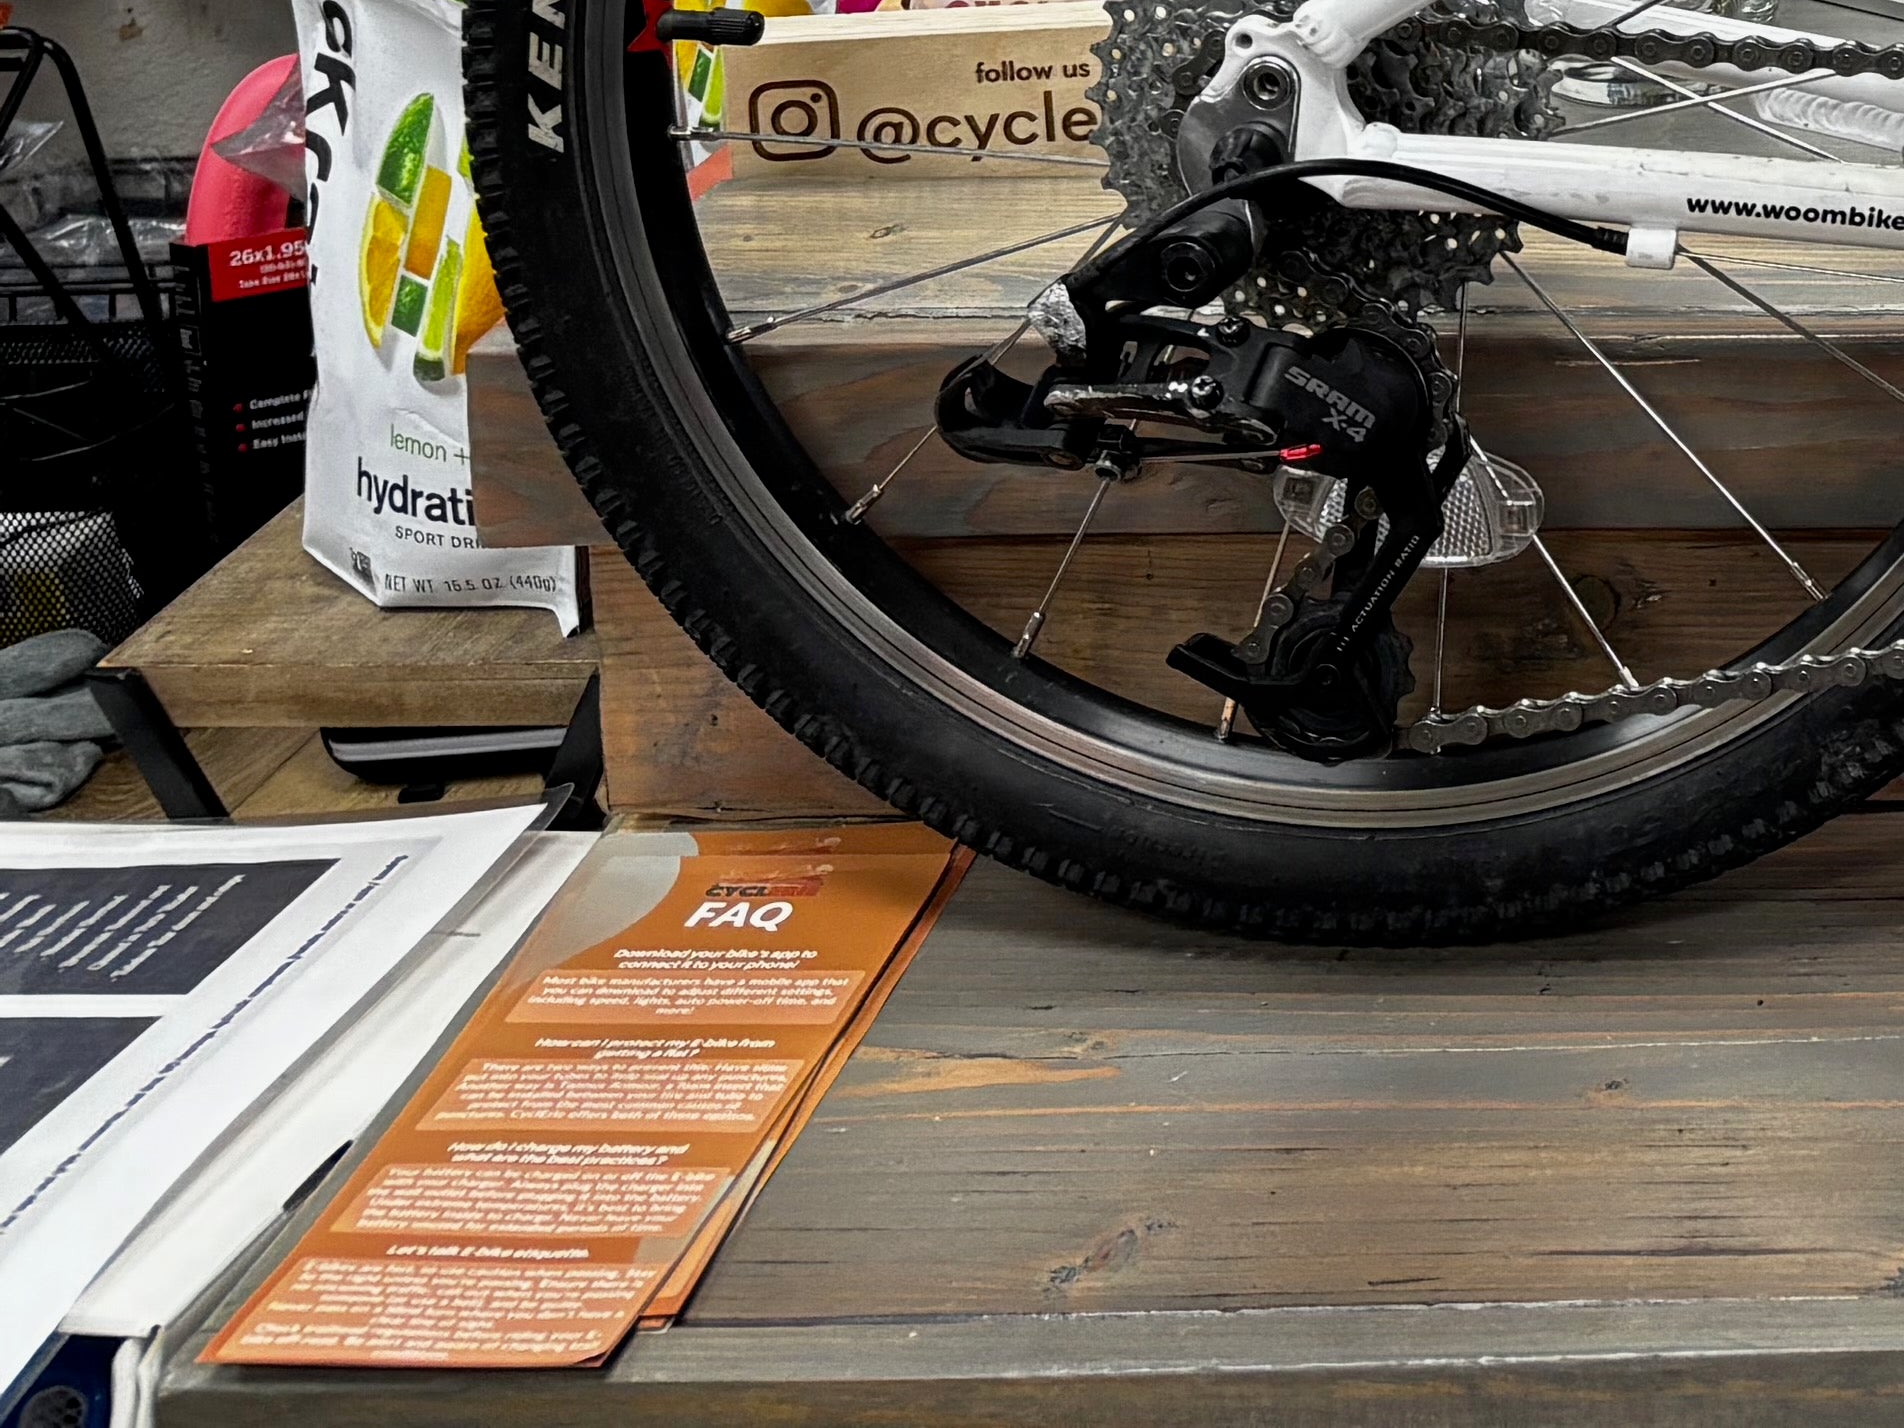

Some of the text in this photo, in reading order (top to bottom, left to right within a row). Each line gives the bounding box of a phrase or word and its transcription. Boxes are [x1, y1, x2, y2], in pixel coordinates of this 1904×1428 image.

[974, 59, 1092, 86] follow us
[249, 393, 301, 412] Complete
[1283, 364, 1376, 429] SRAM
[389, 424, 447, 463] lemon
[357, 456, 474, 528] hydrati
[394, 523, 487, 550] SPORT DRI
[384, 573, 408, 593] NET
[413, 574, 435, 593] WT
[482, 575, 506, 593] OZ
[509, 573, 558, 596] (440g)
[1350, 534, 1421, 633] ACTUATION RATIO
[684, 901, 794, 932] FAQ
[614, 948, 818, 961] Download your bike's app to
[618, 961, 682, 970] connect
[692, 961, 709, 970] to
[707, 962, 746, 972] your
